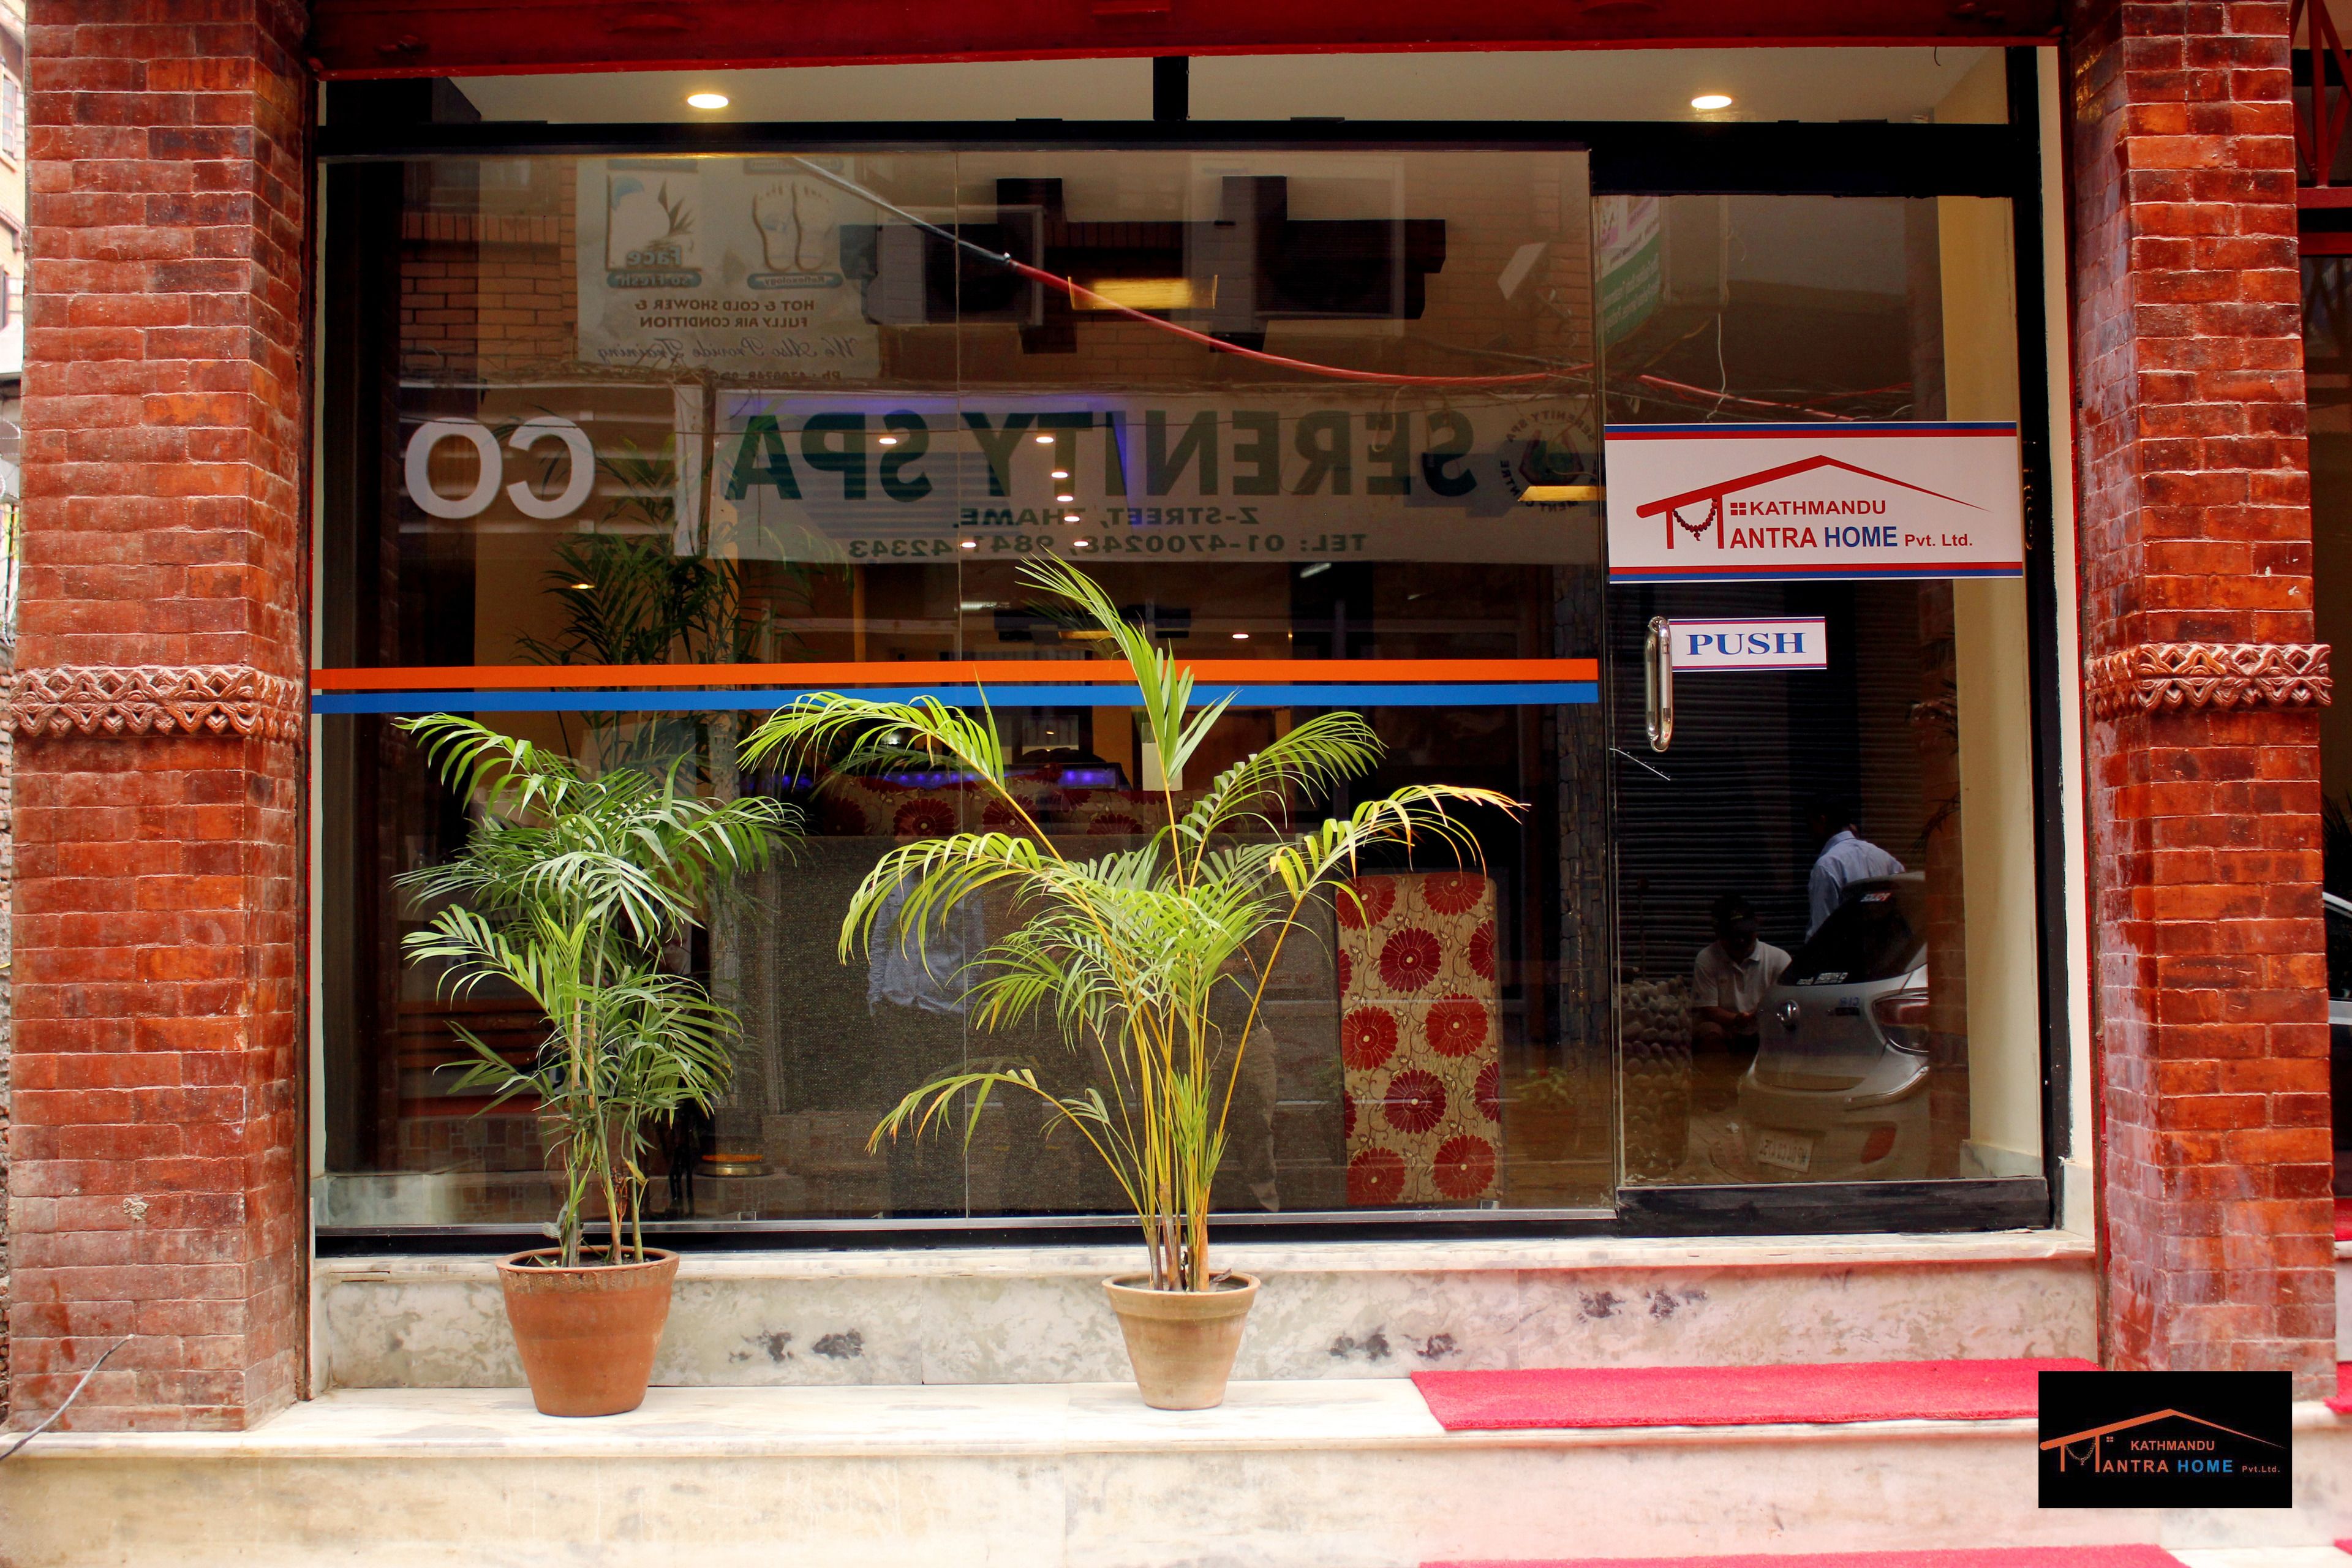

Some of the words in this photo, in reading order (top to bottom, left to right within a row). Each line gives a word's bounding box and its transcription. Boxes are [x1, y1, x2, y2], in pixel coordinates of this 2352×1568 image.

[1749, 500, 1887, 517] KATHMANDU
[1824, 525, 1898, 548] HOME
[1904, 533, 1937, 548] Pvt.
[1940, 533, 1973, 547] Ltd.
[1686, 631, 1806, 655] PUSH
